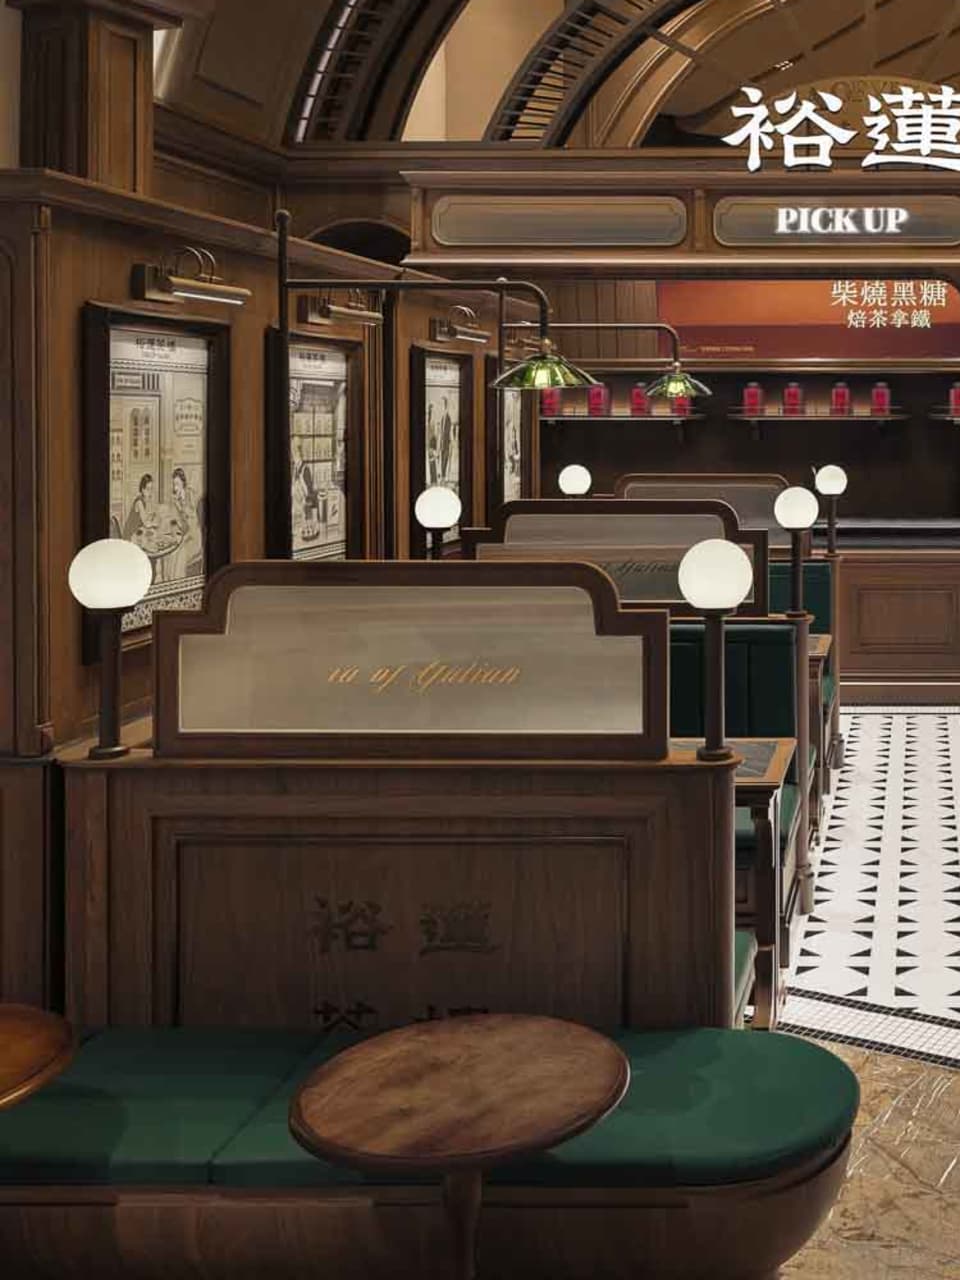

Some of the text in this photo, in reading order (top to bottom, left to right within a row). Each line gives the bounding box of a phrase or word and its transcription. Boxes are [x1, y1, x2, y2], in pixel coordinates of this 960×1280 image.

[776, 207, 909, 233] PICK UP
[831, 280, 947, 307] 柴燒黑糖
